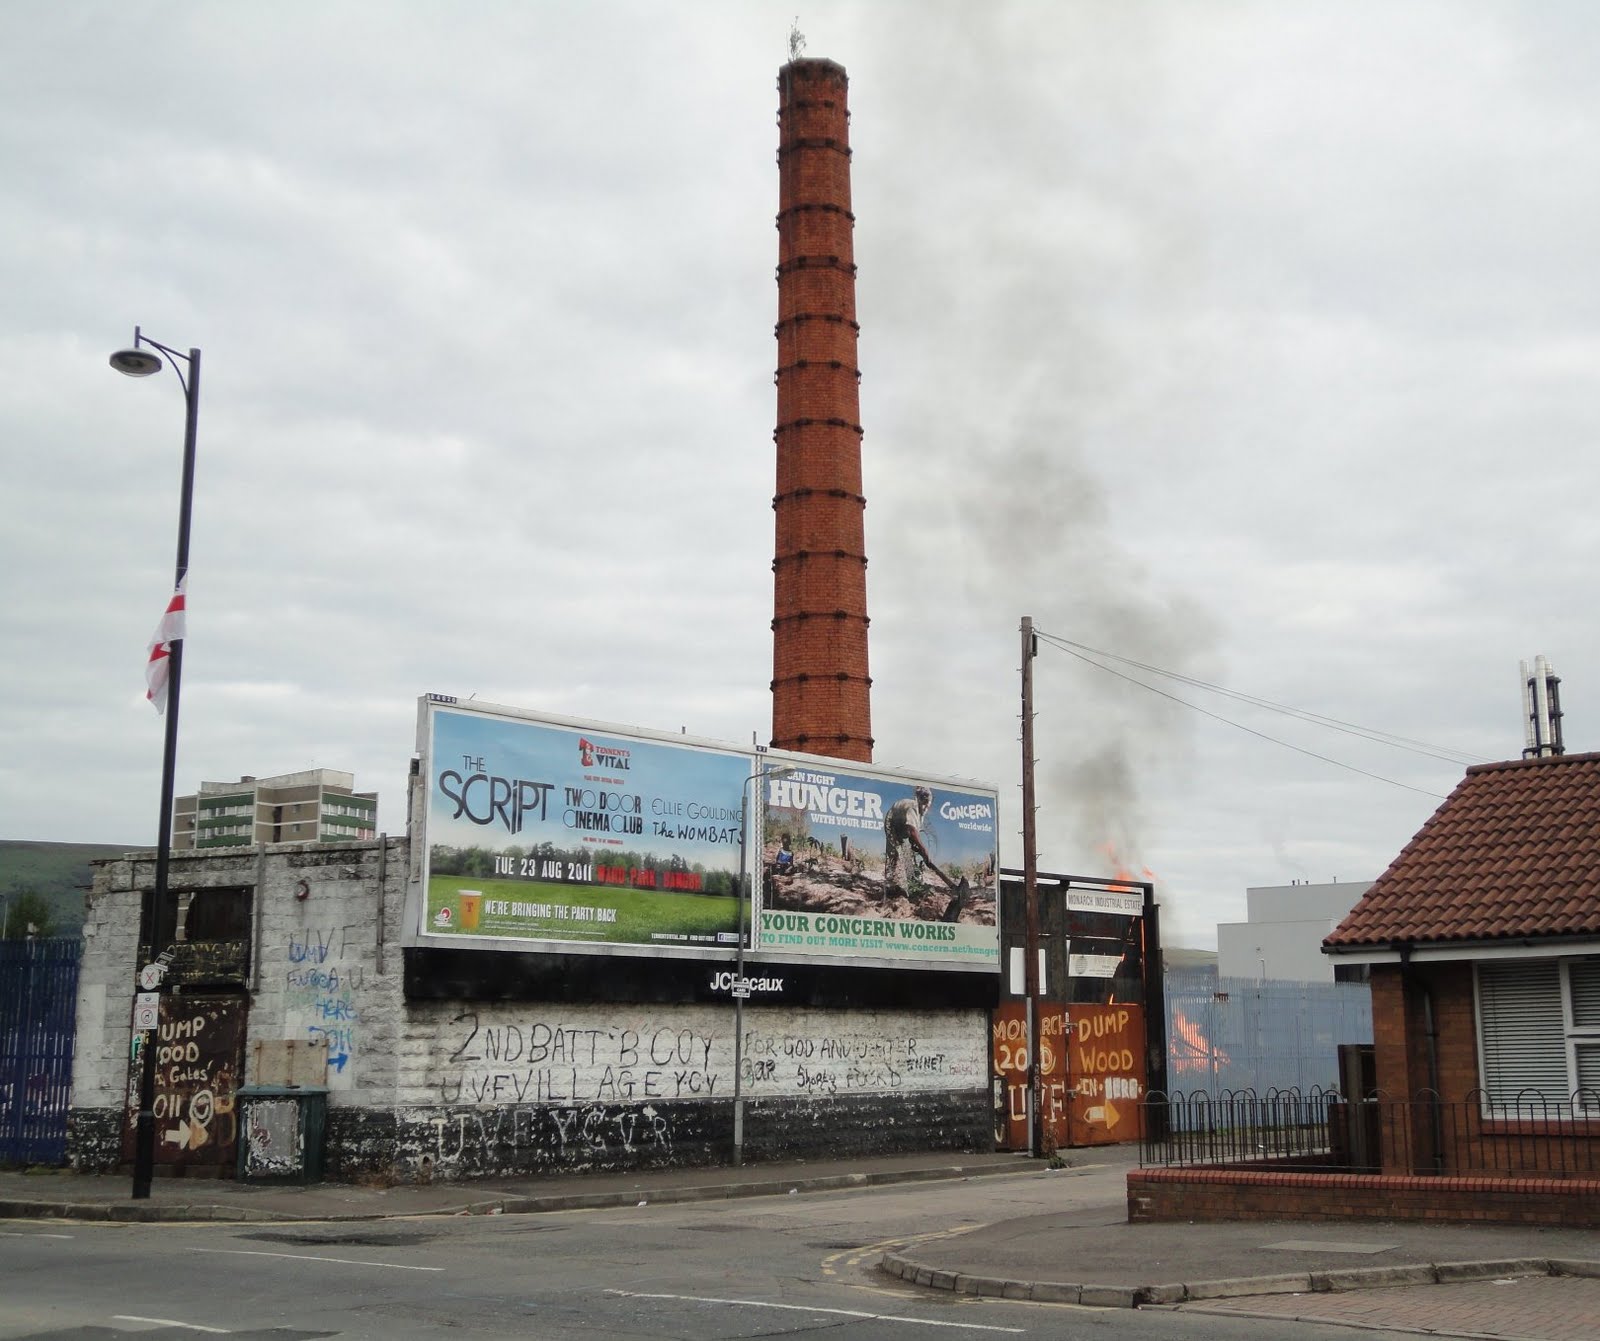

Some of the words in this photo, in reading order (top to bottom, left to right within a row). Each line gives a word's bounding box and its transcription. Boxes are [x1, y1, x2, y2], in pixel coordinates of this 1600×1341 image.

[463, 755, 486, 772] THE
[595, 746, 630, 758] TENNENT'S
[596, 754, 630, 770] VITAL
[807, 773, 835, 786] FIGHT
[565, 787, 596, 808] TWO
[600, 792, 641, 814] DOOR
[652, 798, 682, 816] ELLIE
[687, 802, 743, 822] GOULDING
[769, 780, 884, 819] HUNGER
[563, 809, 610, 832] CINEMA
[611, 814, 643, 835] CLUB
[653, 822, 675, 840] The
[677, 824, 744, 845] WOMBATS
[810, 813, 835, 826] WITH
[835, 816, 860, 828] YOUR
[860, 819, 884, 831] HELP
[958, 822, 992, 833] worldwide
[495, 856, 514, 875] TUE
[520, 858, 535, 877] 23
[541, 860, 562, 879] AUG
[568, 862, 592, 882] 2011
[485, 900, 509, 916] WE'RE
[511, 902, 551, 918] BRINGING
[554, 905, 569, 920] THE
[571, 906, 595, 921] PARTY
[597, 908, 617, 922] BACK
[1068, 894, 1094, 906] MONARCH
[1095, 897, 1123, 909] INDUSTRIAL
[1124, 899, 1141, 911] ESTATE
[761, 913, 810, 933] YOUR
[814, 916, 896, 937] CONCERN
[899, 922, 956, 941] WORKS
[760, 933, 776, 944] TO
[778, 934, 803, 945] FIND
[806, 936, 826, 946] OUT
[828, 937, 858, 948] MORE
[860, 938, 884, 949] VISIT
[316, 998, 358, 1021] HERE
[157, 1016, 205, 1041] UMP
[993, 1014, 1063, 1041] MONRCH
[1079, 1010, 1130, 1042] DUMP
[156, 1041, 200, 1065] OOD
[650, 1026, 716, 1072] COY
[784, 1036, 815, 1059] GOD
[1080, 1047, 1134, 1074] WOOD
